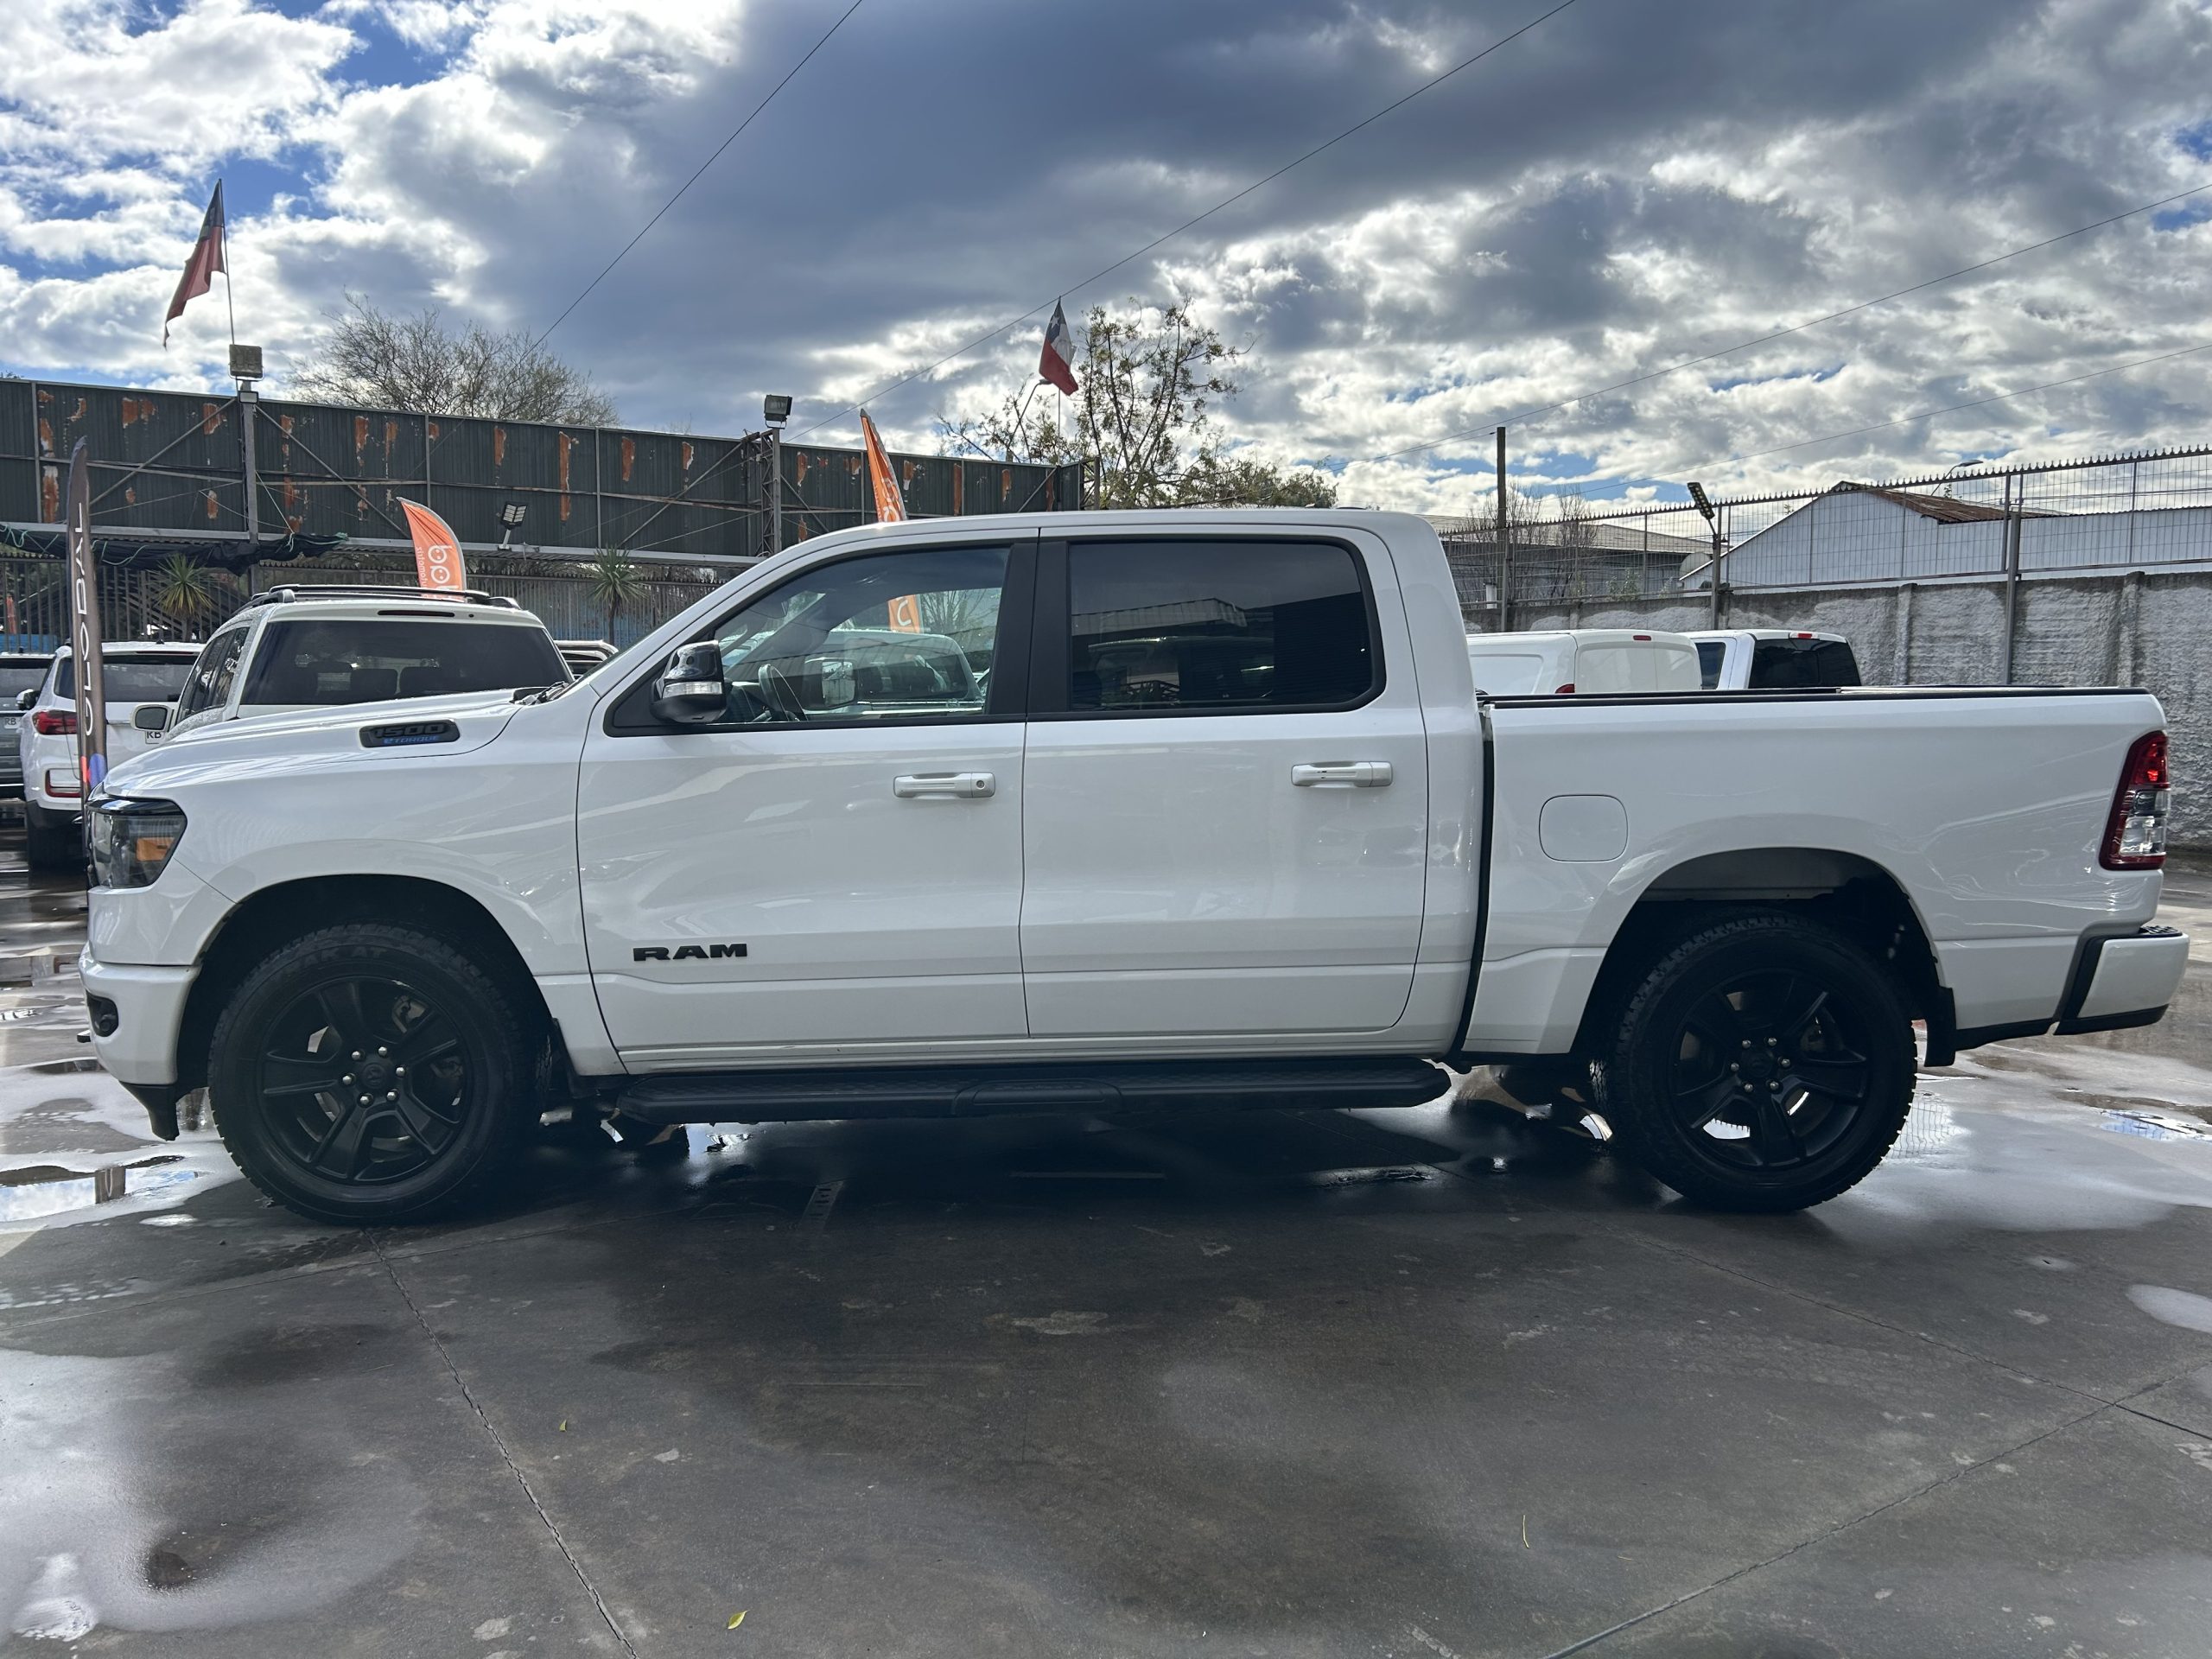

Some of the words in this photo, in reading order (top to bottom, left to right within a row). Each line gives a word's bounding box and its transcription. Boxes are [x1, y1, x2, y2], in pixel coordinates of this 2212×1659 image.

[74, 502, 94, 736] GLOBAL
[372, 724, 445, 739] 1500
[632, 943, 748, 962] RAM
